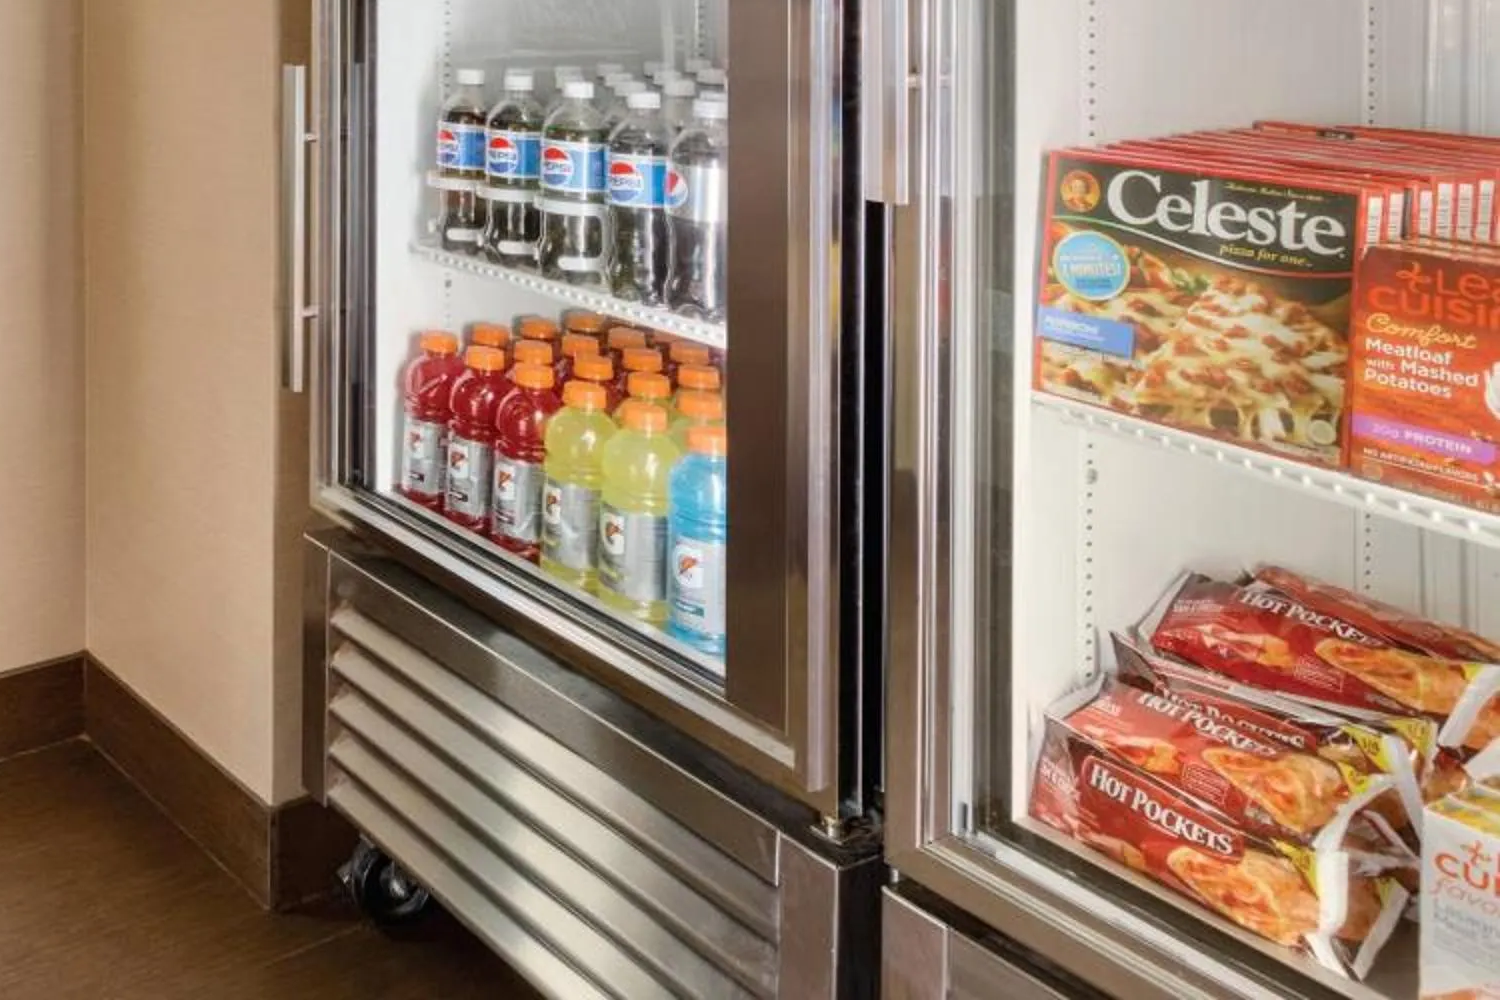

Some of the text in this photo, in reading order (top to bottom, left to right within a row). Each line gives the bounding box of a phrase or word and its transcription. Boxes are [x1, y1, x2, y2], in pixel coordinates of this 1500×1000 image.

[1106, 169, 1348, 257] Celeste
[1257, 246, 1279, 262] for
[1366, 311, 1478, 350] Comfort
[1365, 336, 1454, 366] Meatloaf
[1363, 367, 1453, 400] Potatoes
[1365, 358, 1480, 388] with Mashed
[1403, 429, 1473, 455] PROTEIN
[1138, 692, 1184, 718] HOT
[1089, 763, 1130, 804] HOT
[1131, 785, 1234, 856] POCKETS
